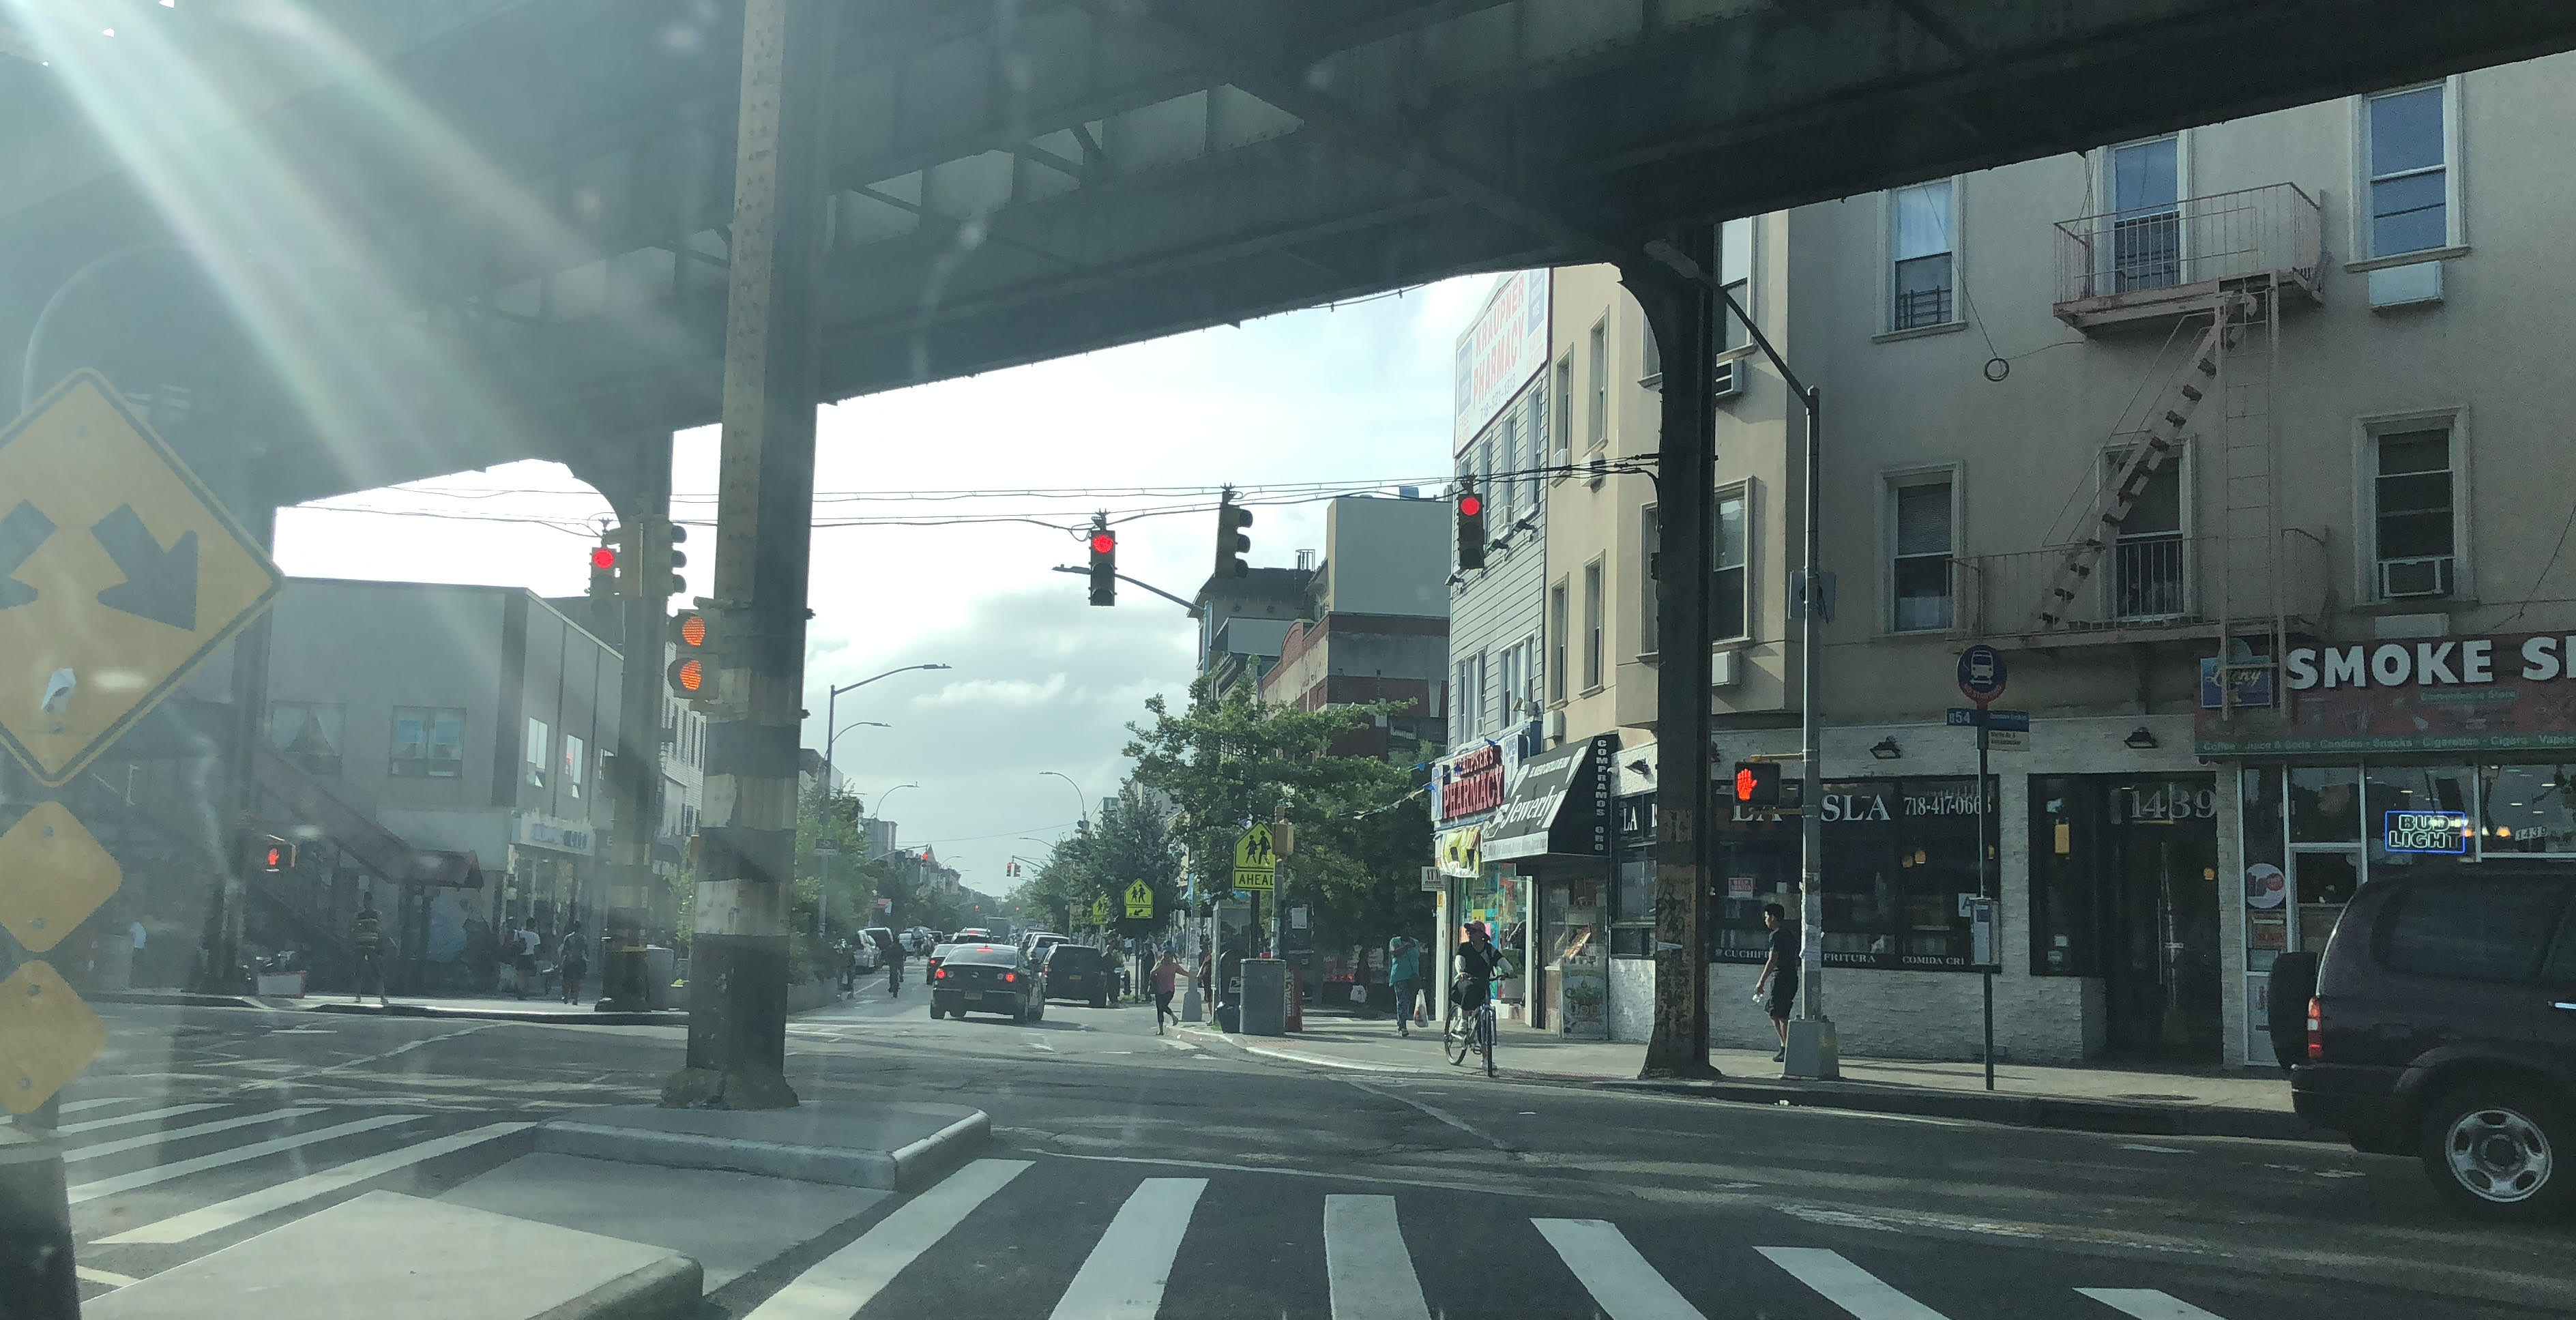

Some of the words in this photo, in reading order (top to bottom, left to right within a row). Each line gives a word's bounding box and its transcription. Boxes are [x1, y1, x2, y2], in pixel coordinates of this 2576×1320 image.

[1476, 274, 1525, 359] KRAUPNER
[1474, 312, 1525, 409] PHARMACY
[2287, 640, 2493, 690] SMOKE
[1443, 765, 1504, 819] PHARMACY
[1594, 739, 1608, 817] COMPRAMOS
[1500, 785, 1557, 830] Jewerly
[1821, 794, 1891, 822] SLA
[2130, 788, 2218, 819] 1439
[1624, 806, 1638, 832] LA
[2399, 815, 2450, 832] BUD
[2517, 826, 2548, 840] 1439
[2388, 830, 2461, 849] LIGHT
[1724, 949, 1770, 958] CUCHIF
[1824, 953, 1876, 963] FRITURA
[1902, 955, 1943, 965] COMIDA
